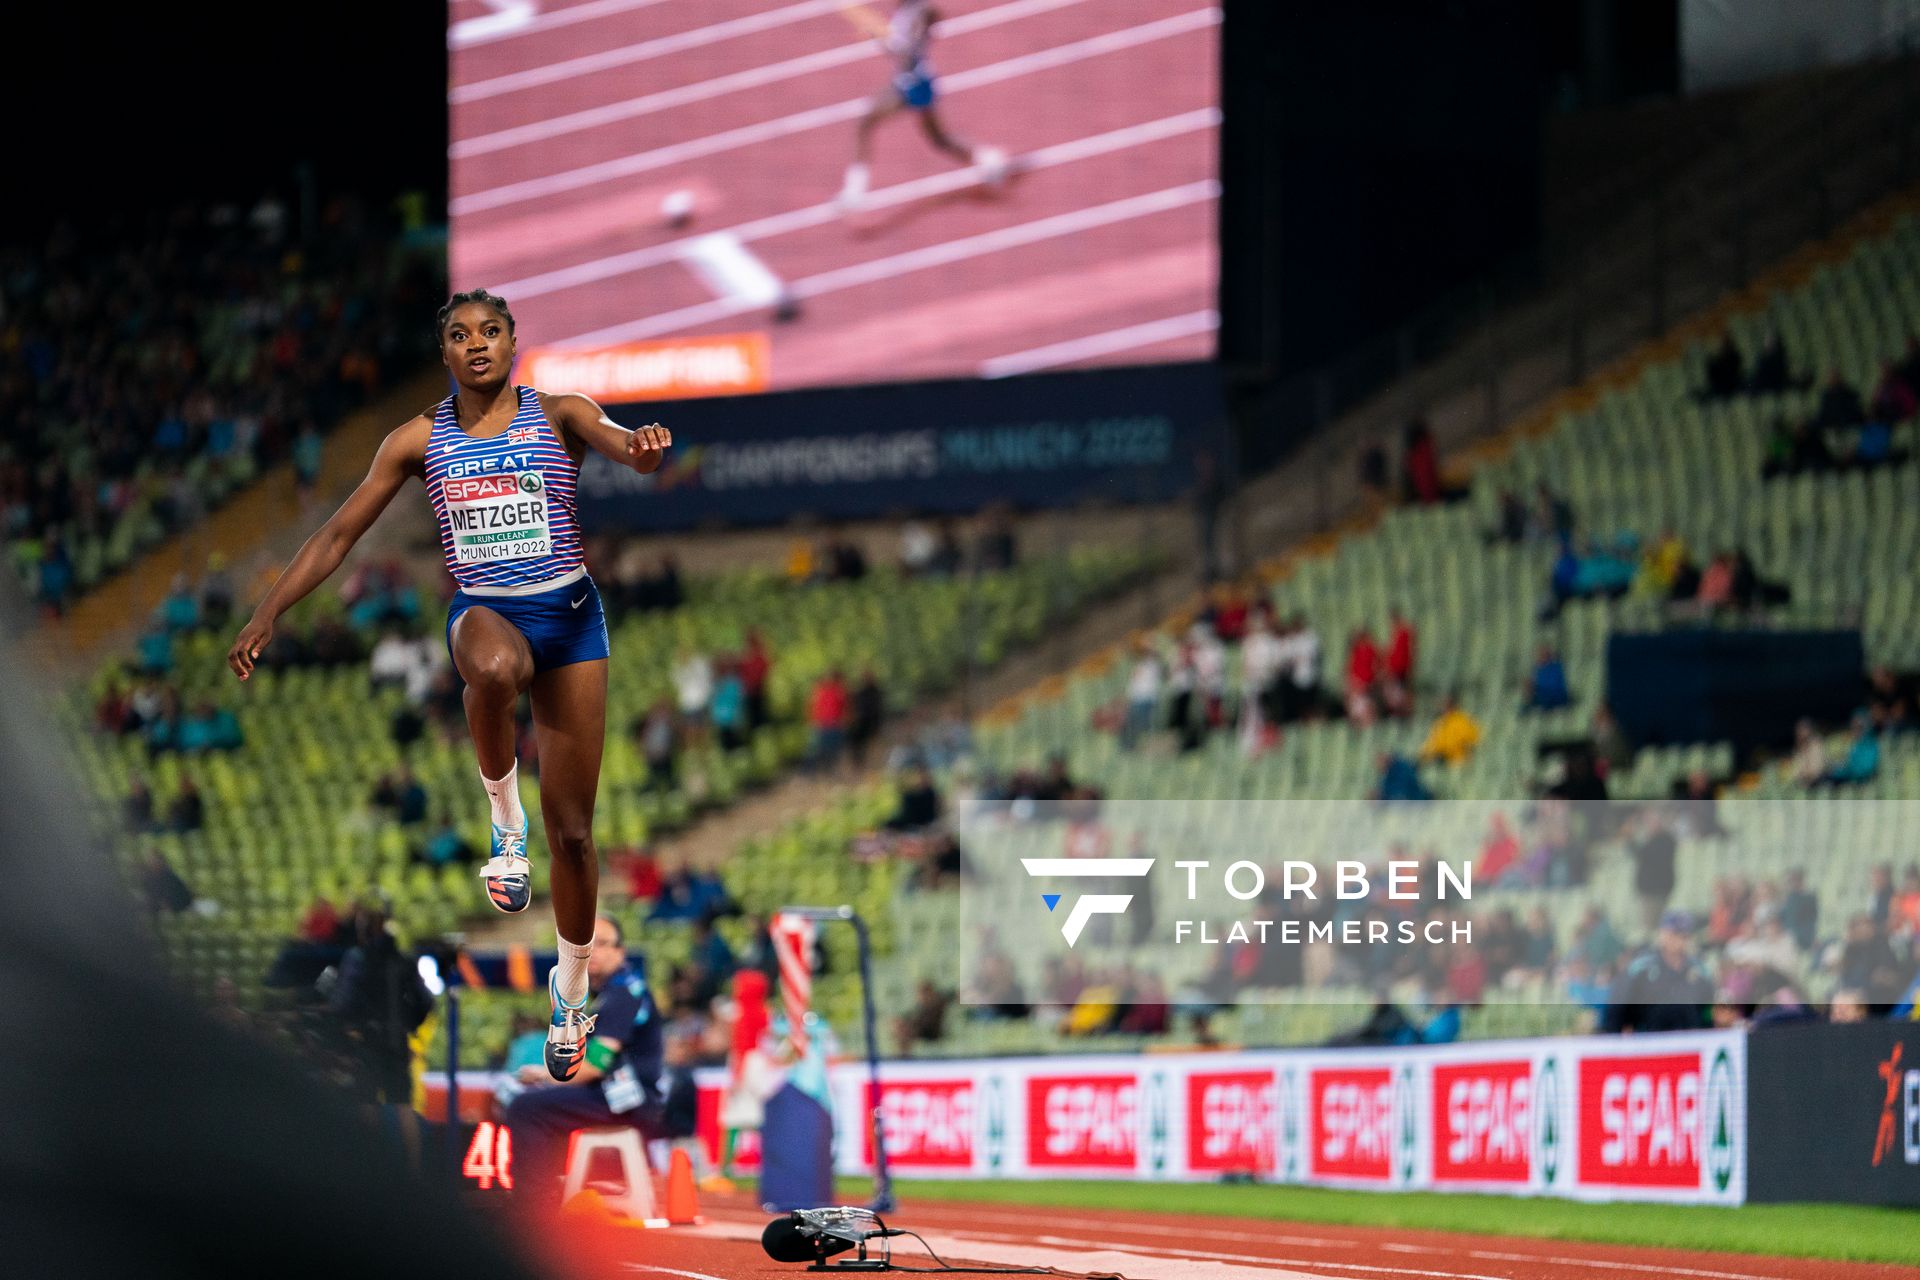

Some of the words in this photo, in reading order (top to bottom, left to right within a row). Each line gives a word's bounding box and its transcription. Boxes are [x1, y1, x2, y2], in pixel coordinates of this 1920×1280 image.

[448, 453, 532, 478] GREAT
[446, 477, 516, 499] SPAR
[451, 501, 545, 531] METZGER
[460, 545, 509, 560] MUNICH
[514, 540, 546, 555] 2022
[477, 534, 495, 544] RUN
[1449, 1077, 1531, 1164] SPAR
[1602, 1072, 1700, 1166] SPAR
